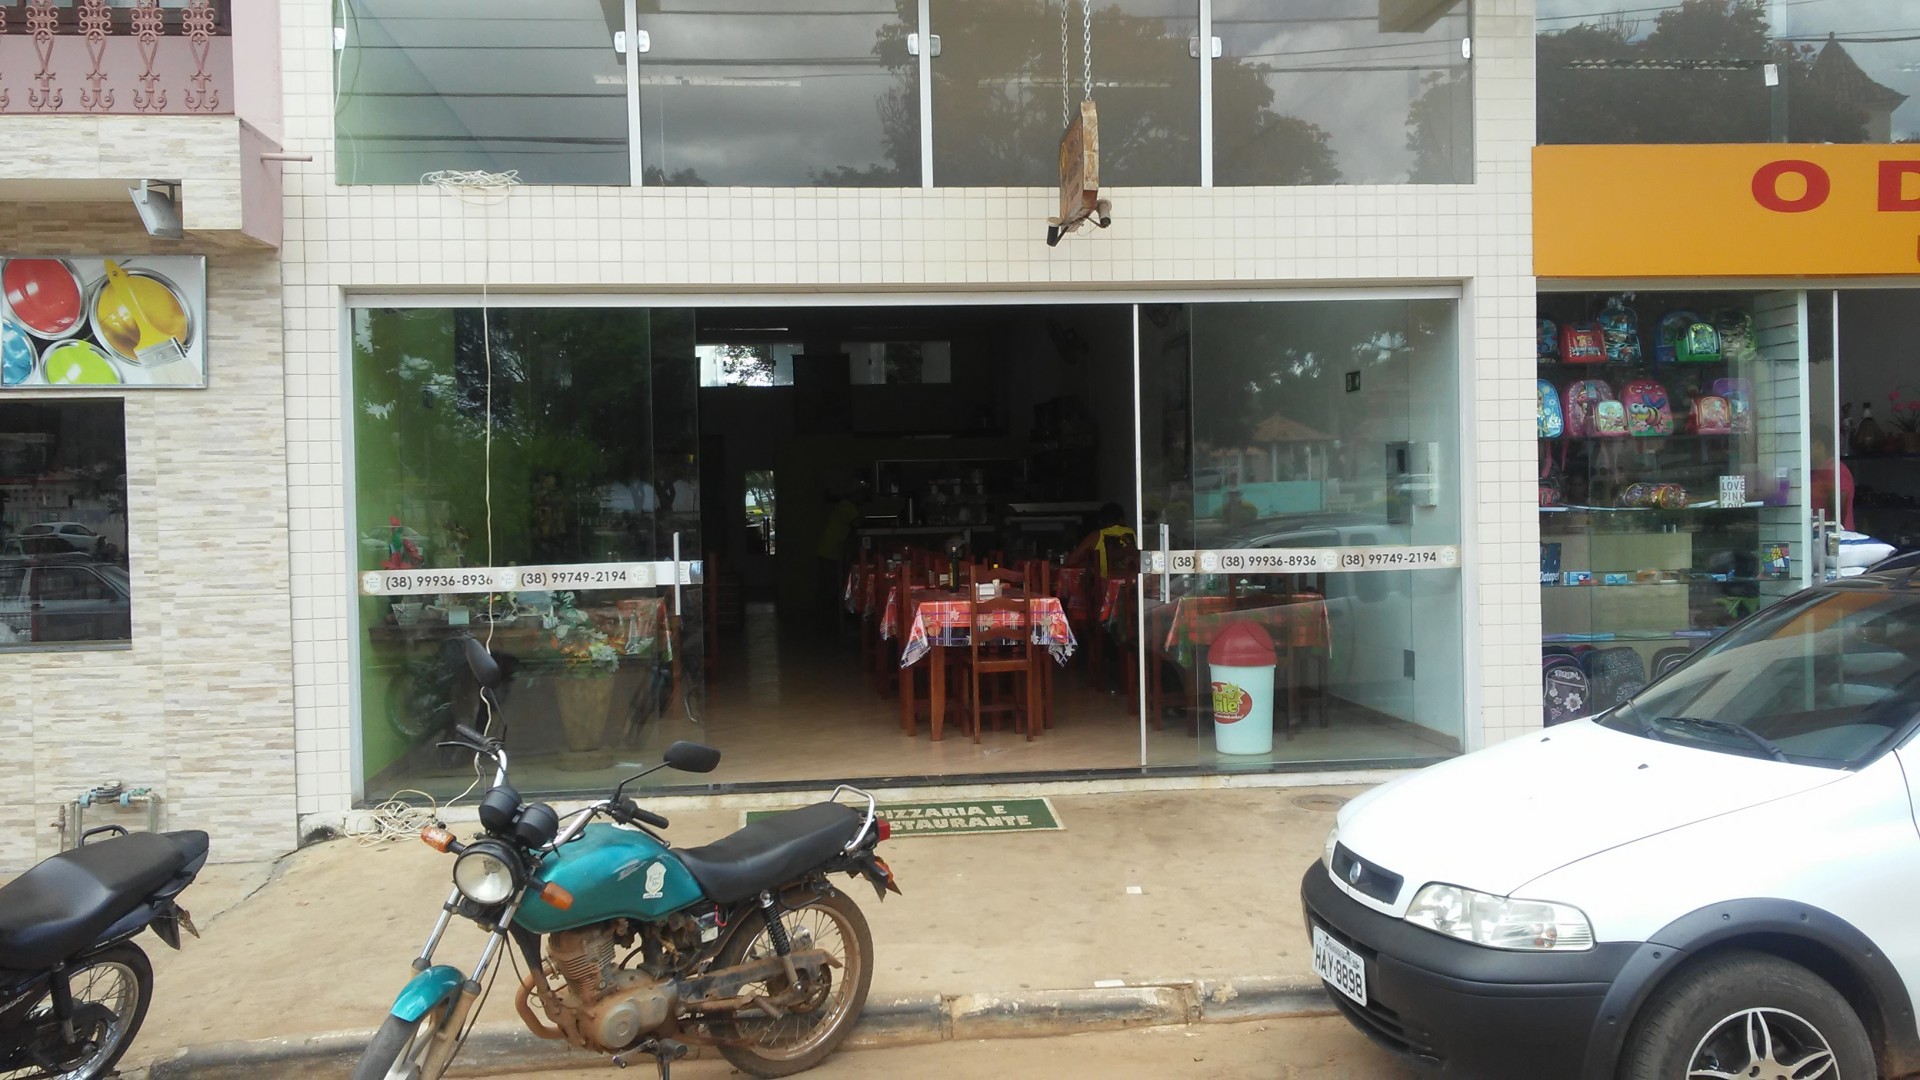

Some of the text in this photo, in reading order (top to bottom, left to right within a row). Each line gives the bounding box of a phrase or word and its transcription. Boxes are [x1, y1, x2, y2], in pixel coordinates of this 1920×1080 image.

[1752, 160, 1831, 213] O
[1722, 481, 1746, 491] LOVE
[1722, 491, 1746, 501] PINK
[1173, 556, 1196, 570] (38)
[1221, 551, 1437, 569] (38) 99936-8936 (38) 99749-2194
[386, 575, 412, 590] (38)
[416, 574, 493, 588] 99936-8936
[521, 572, 547, 587] (38)
[551, 570, 627, 584] 99749-2194
[873, 805, 1008, 820] PIZZARIA E
[889, 815, 1033, 831] STAURANTE
